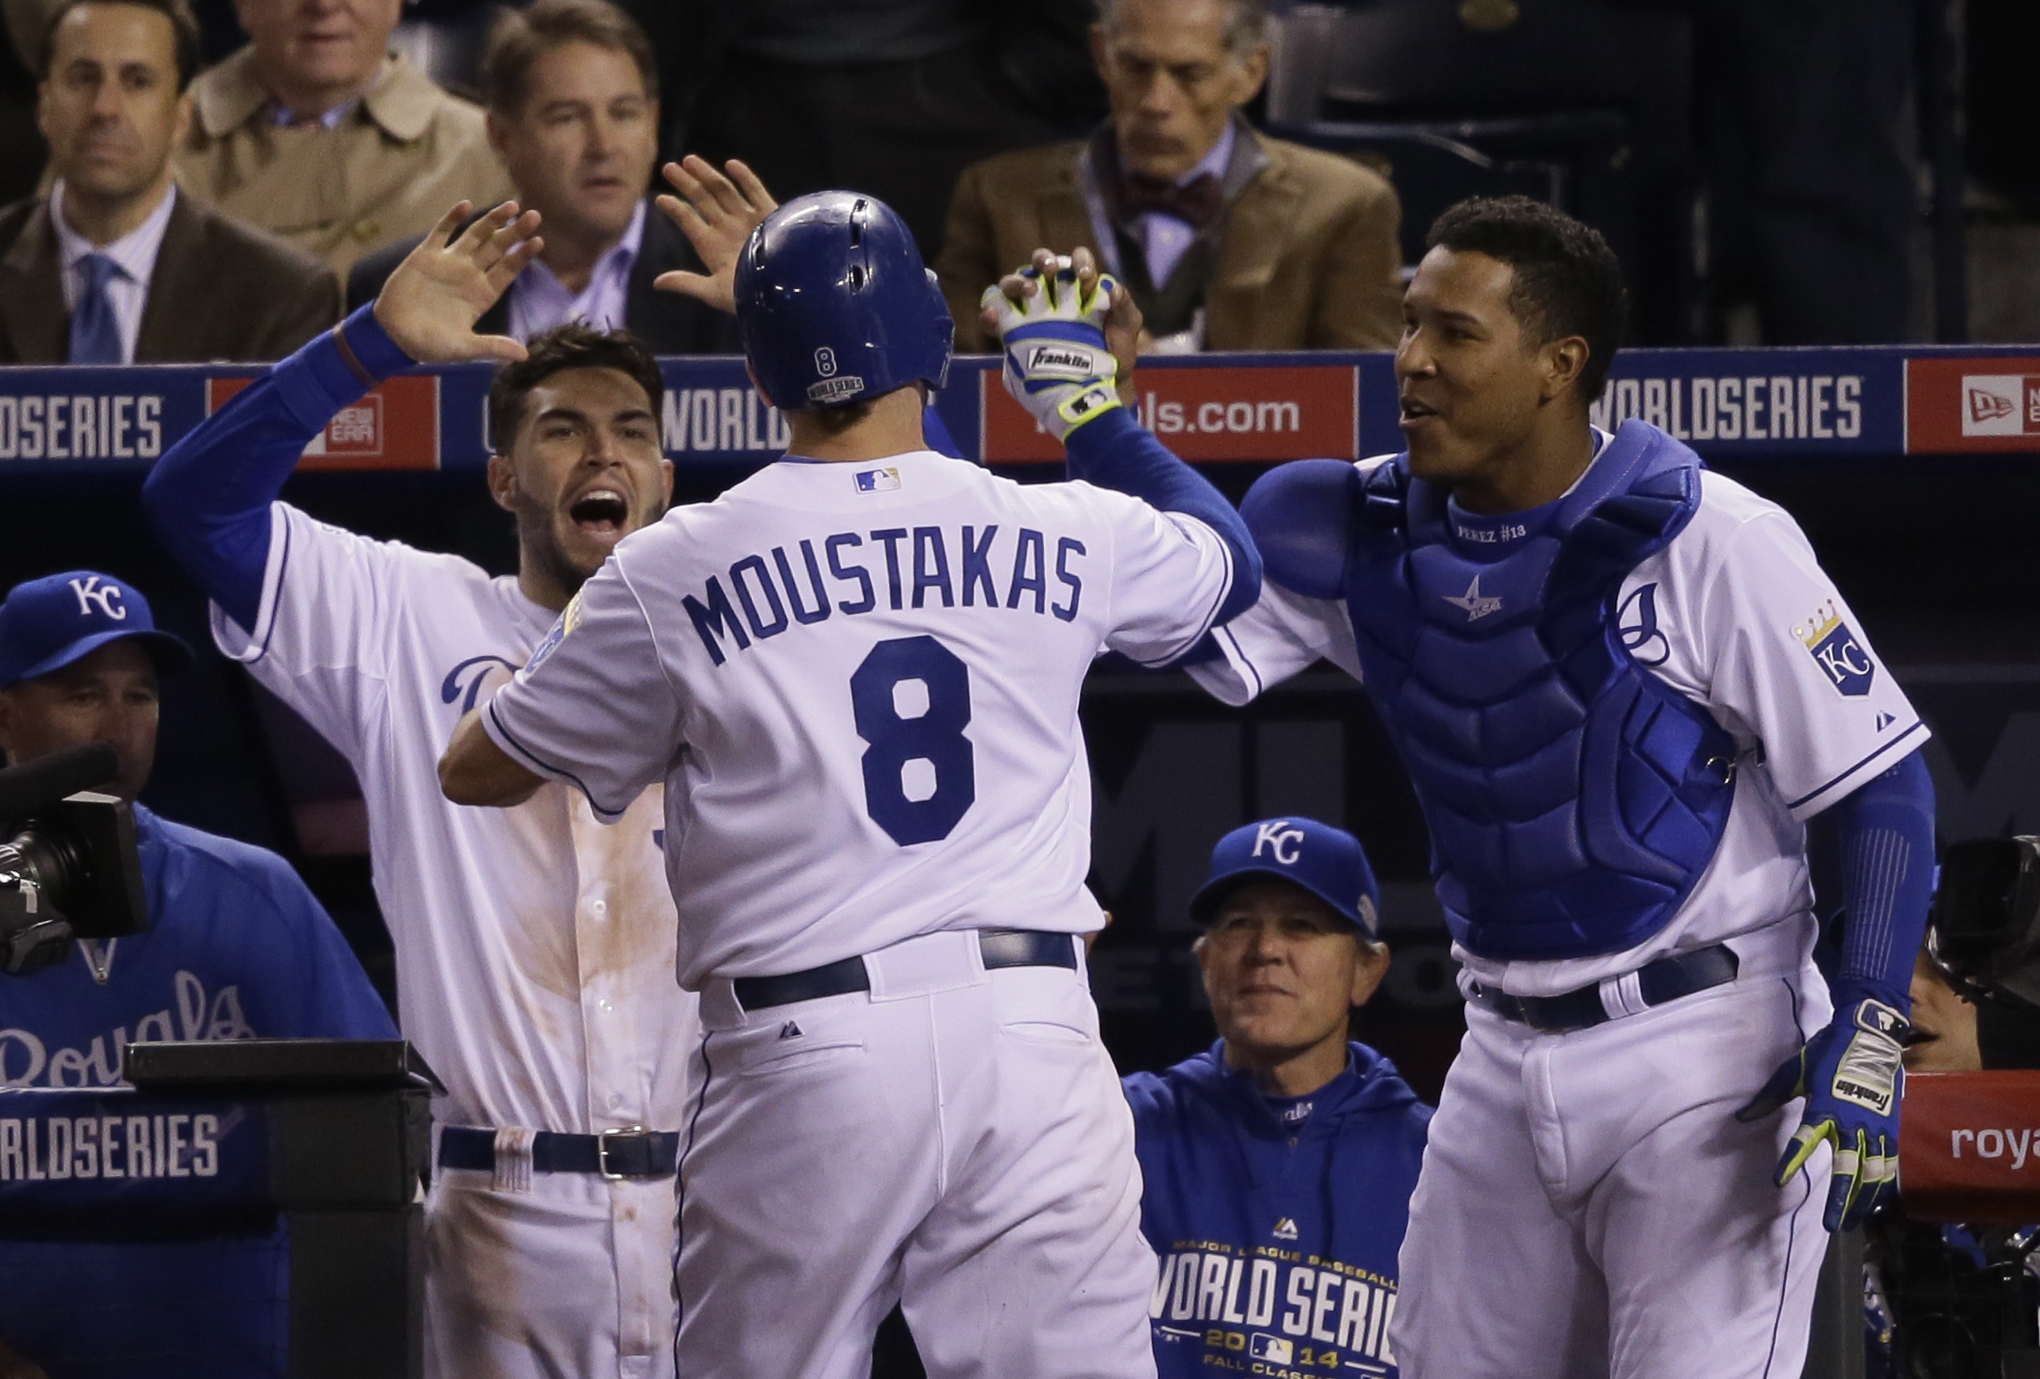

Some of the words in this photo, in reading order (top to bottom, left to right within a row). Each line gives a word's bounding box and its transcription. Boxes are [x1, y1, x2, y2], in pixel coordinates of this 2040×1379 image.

[814, 347, 837, 377] 8
[1458, 526, 1497, 543] PEREZ
[67, 576, 126, 620] KC
[681, 525, 1087, 667] MOUSTAKAS
[1817, 639, 1870, 685] KC
[849, 635, 975, 847] 8
[1252, 821, 1304, 865] KC
[1174, 1241, 1232, 1254] MAJOR
[1238, 1246, 1302, 1263] LAGUE
[1205, 1329, 1247, 1351] 20
[1203, 1354, 1246, 1370] FALL
[1300, 1347, 1340, 1369] 14
